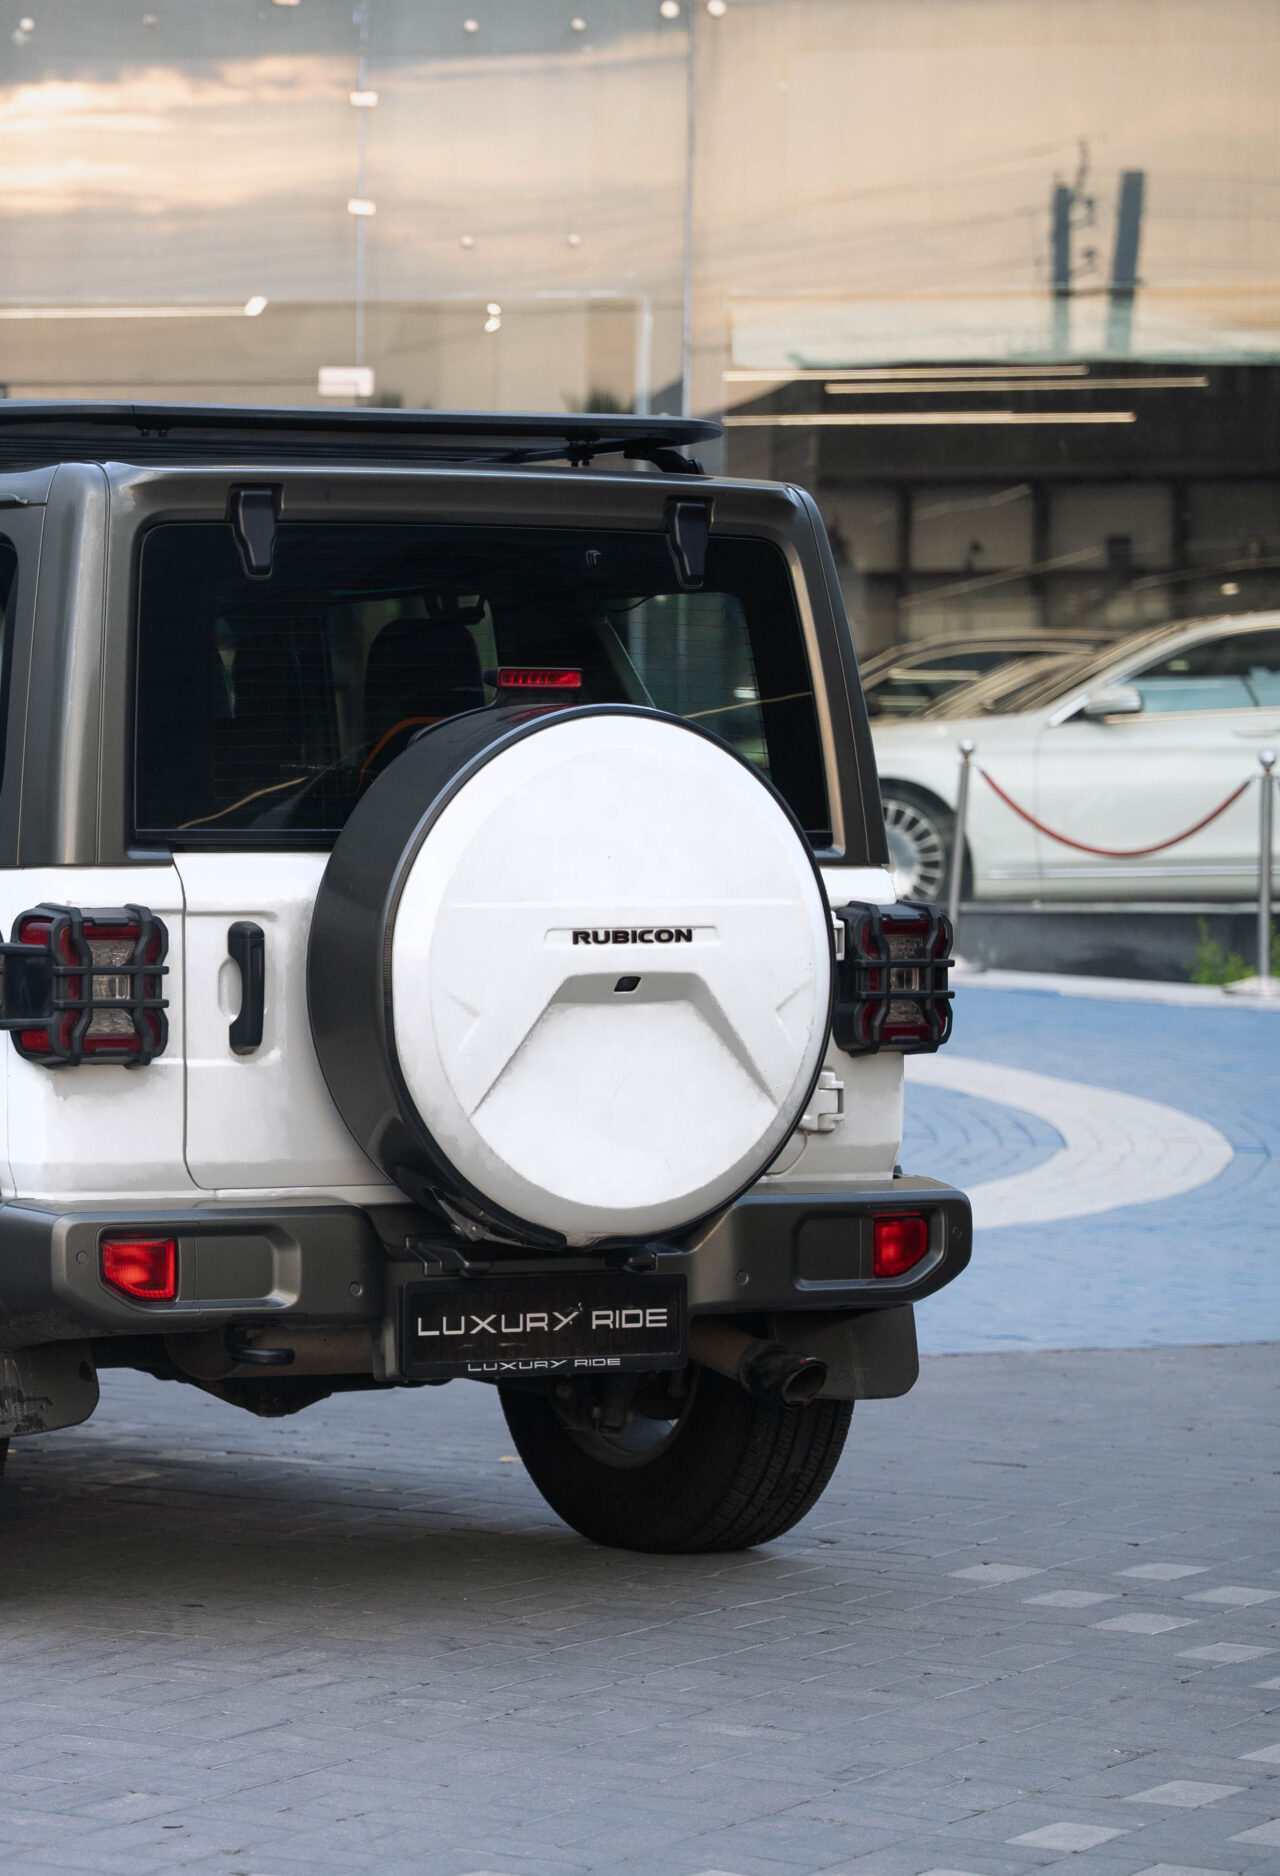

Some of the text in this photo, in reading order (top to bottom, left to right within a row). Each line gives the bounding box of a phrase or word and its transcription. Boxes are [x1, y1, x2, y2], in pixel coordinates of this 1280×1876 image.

[572, 928, 693, 946] RUBICON
[417, 1308, 668, 1337] LUXURY RIDE
[467, 1357, 622, 1372] LUXURY RIDE
